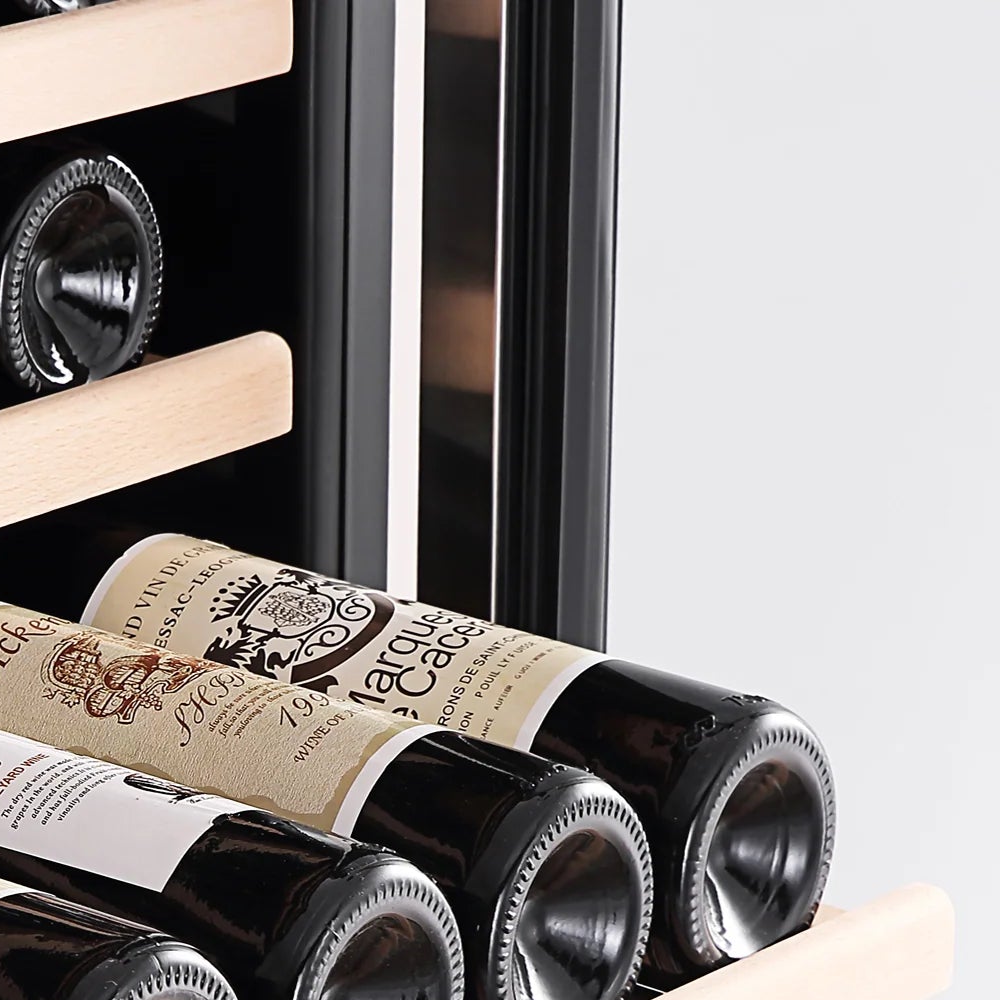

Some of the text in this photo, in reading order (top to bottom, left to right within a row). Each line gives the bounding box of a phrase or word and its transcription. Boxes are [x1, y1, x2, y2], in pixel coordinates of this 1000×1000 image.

[134, 578, 163, 609] VIN
[161, 557, 189, 578] DE
[459, 667, 479, 685] DE
[208, 708, 230, 733] always
[224, 702, 235, 711] be
[294, 719, 332, 763] WINE
[21, 753, 50, 768] WINE
[1, 805, 14, 819] The
[13, 793, 25, 805] dry
[22, 781, 33, 793] red
[31, 770, 46, 785] wine
[10, 805, 29, 830] grapes
[33, 786, 45, 798] the
[31, 788, 57, 820] advanced
[79, 787, 91, 798] and
[41, 810, 53, 826] and
[52, 799, 63, 812] has
